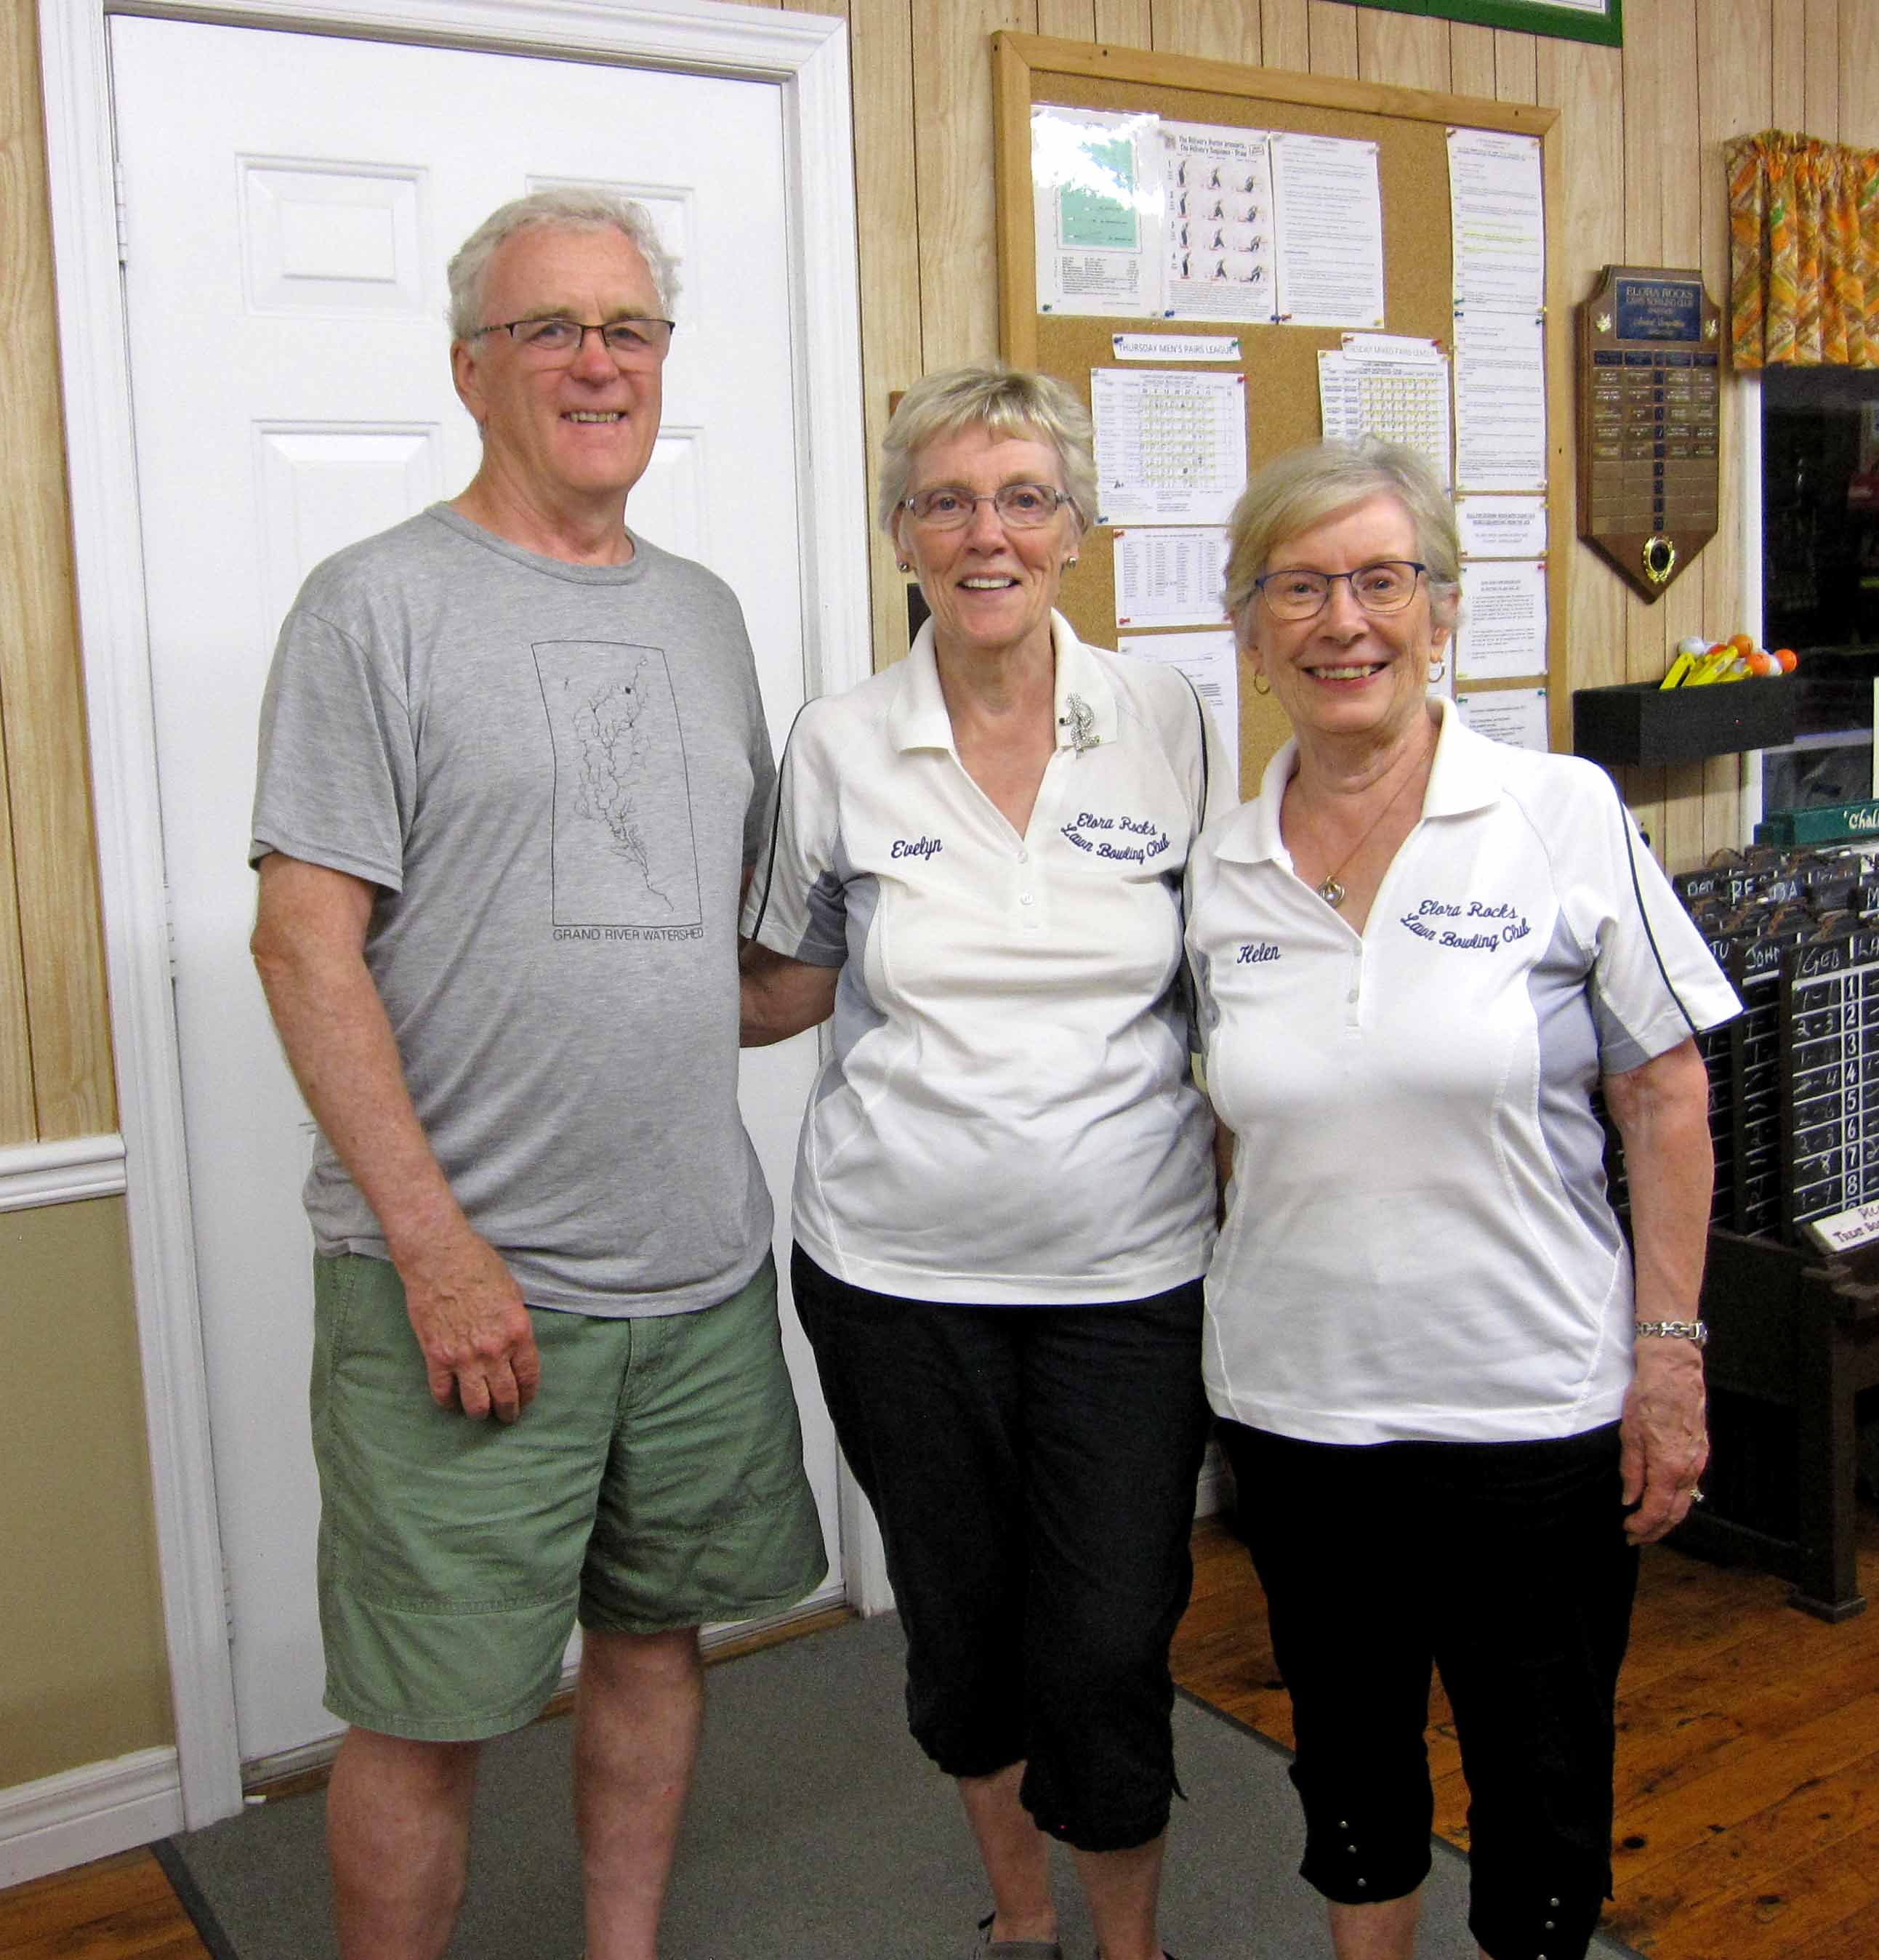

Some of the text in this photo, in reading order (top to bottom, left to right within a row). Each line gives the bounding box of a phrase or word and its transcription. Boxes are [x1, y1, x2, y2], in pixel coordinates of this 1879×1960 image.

[1077, 812, 1157, 836] Elora Rocks
[891, 836, 943, 860] Evelyn
[1061, 823, 1170, 865] Lawn Bowling Club
[1419, 900, 1518, 919] Elora Rocks
[552, 927, 704, 941] GRAND RIVER WATERSHED
[1401, 913, 1531, 952] Lawn Bowling Club
[1236, 943, 1281, 964] Helen
[1847, 976, 1855, 999] 1
[1846, 1004, 1856, 1026] 2
[1848, 1033, 1856, 1055] 3
[1846, 1062, 1856, 1083] 4
[1847, 1091, 1856, 1111] 5
[1847, 1119, 1856, 1140] 6
[1848, 1145, 1857, 1166] 7
[1847, 1174, 1857, 1195] 8
